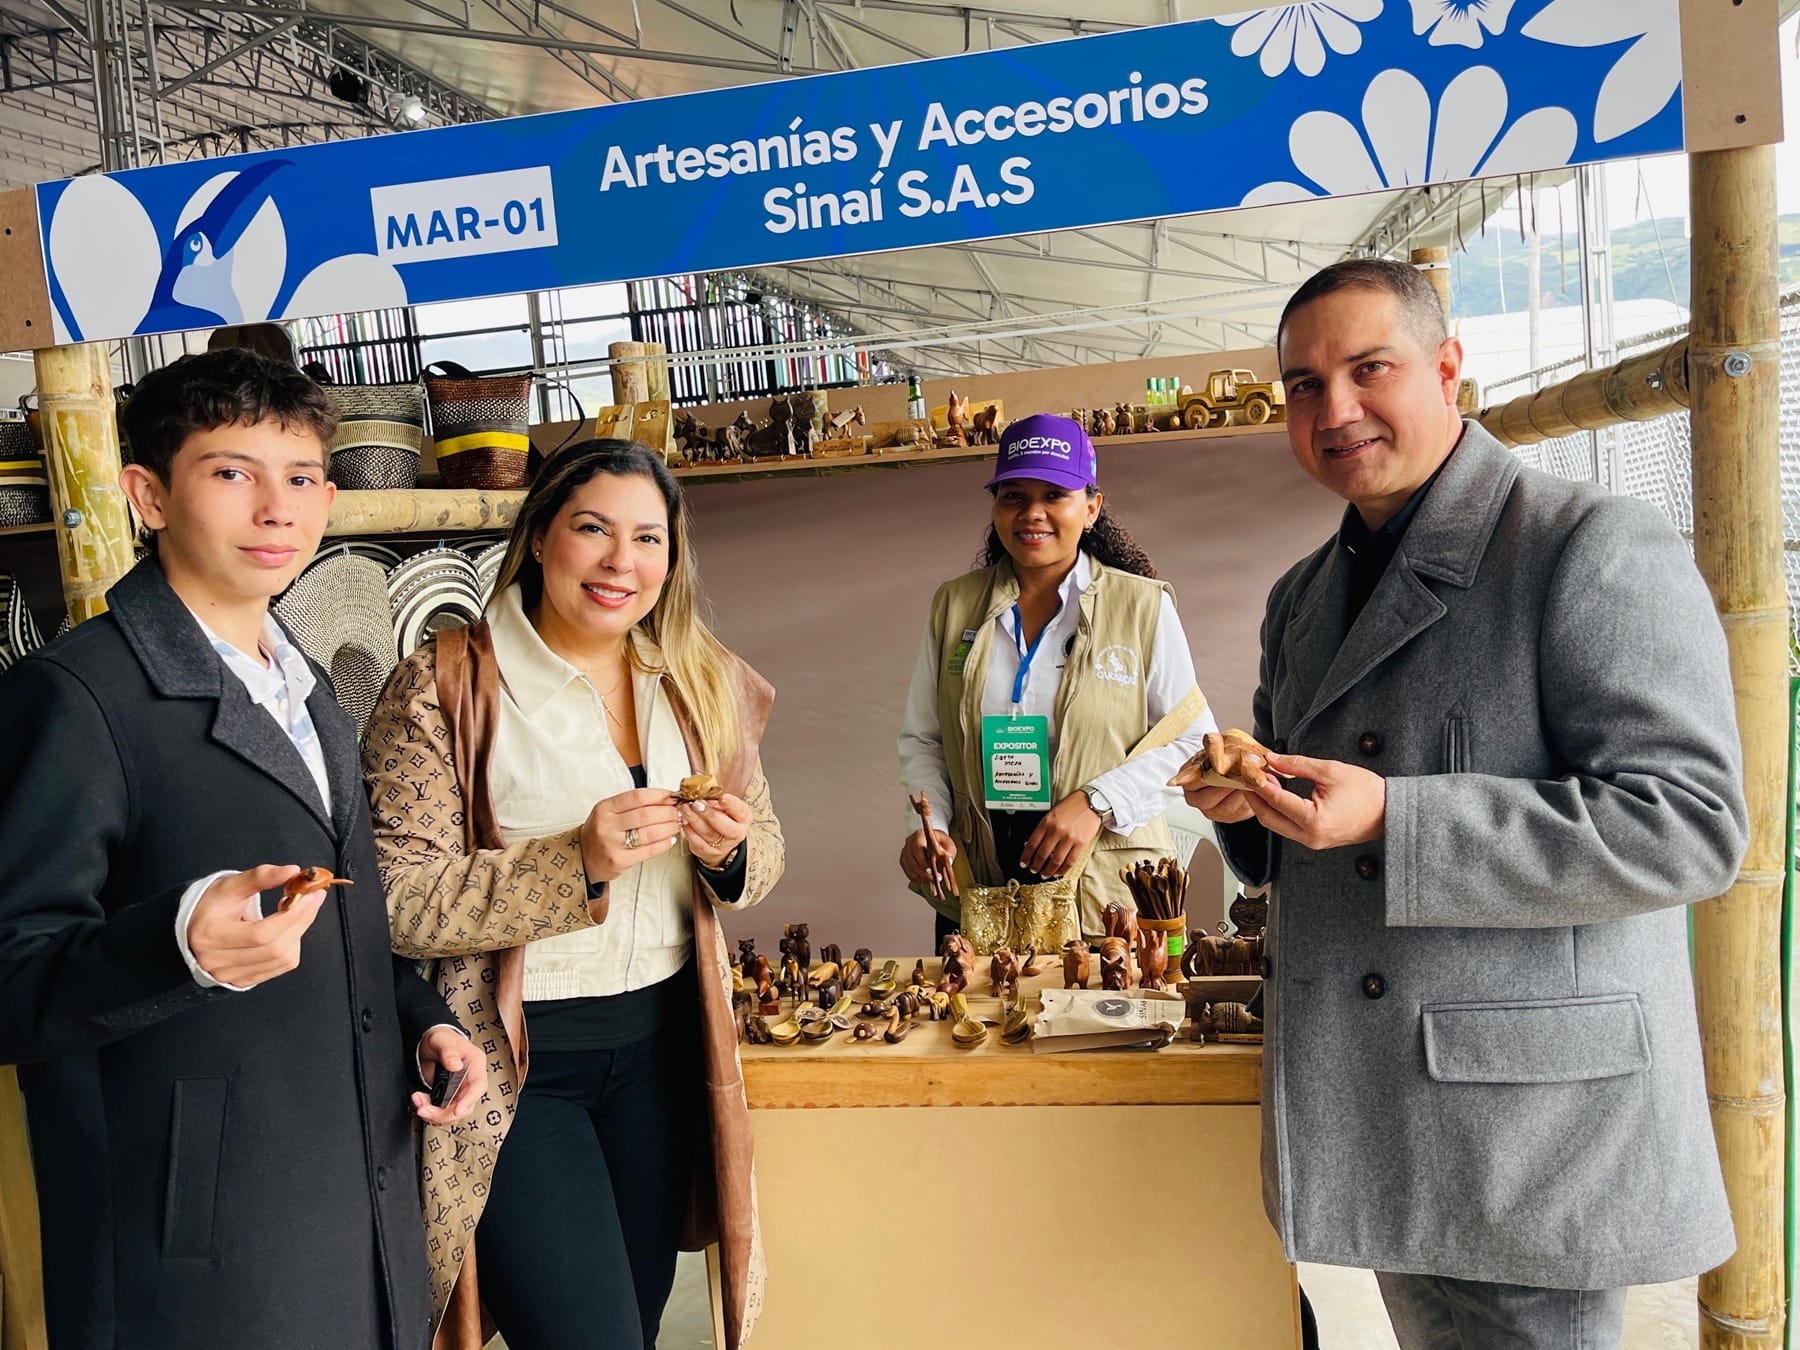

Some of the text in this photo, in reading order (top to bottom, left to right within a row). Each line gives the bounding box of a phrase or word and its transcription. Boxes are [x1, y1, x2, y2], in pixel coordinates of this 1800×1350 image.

[600, 71, 1209, 192] Artesanías y Accesorios
[763, 156, 1035, 234] Sinaí S.A.S
[387, 197, 545, 250] MAR-01
[1008, 437, 1071, 455] BIOEXPO
[993, 742, 1038, 750] EXPOSITOR
